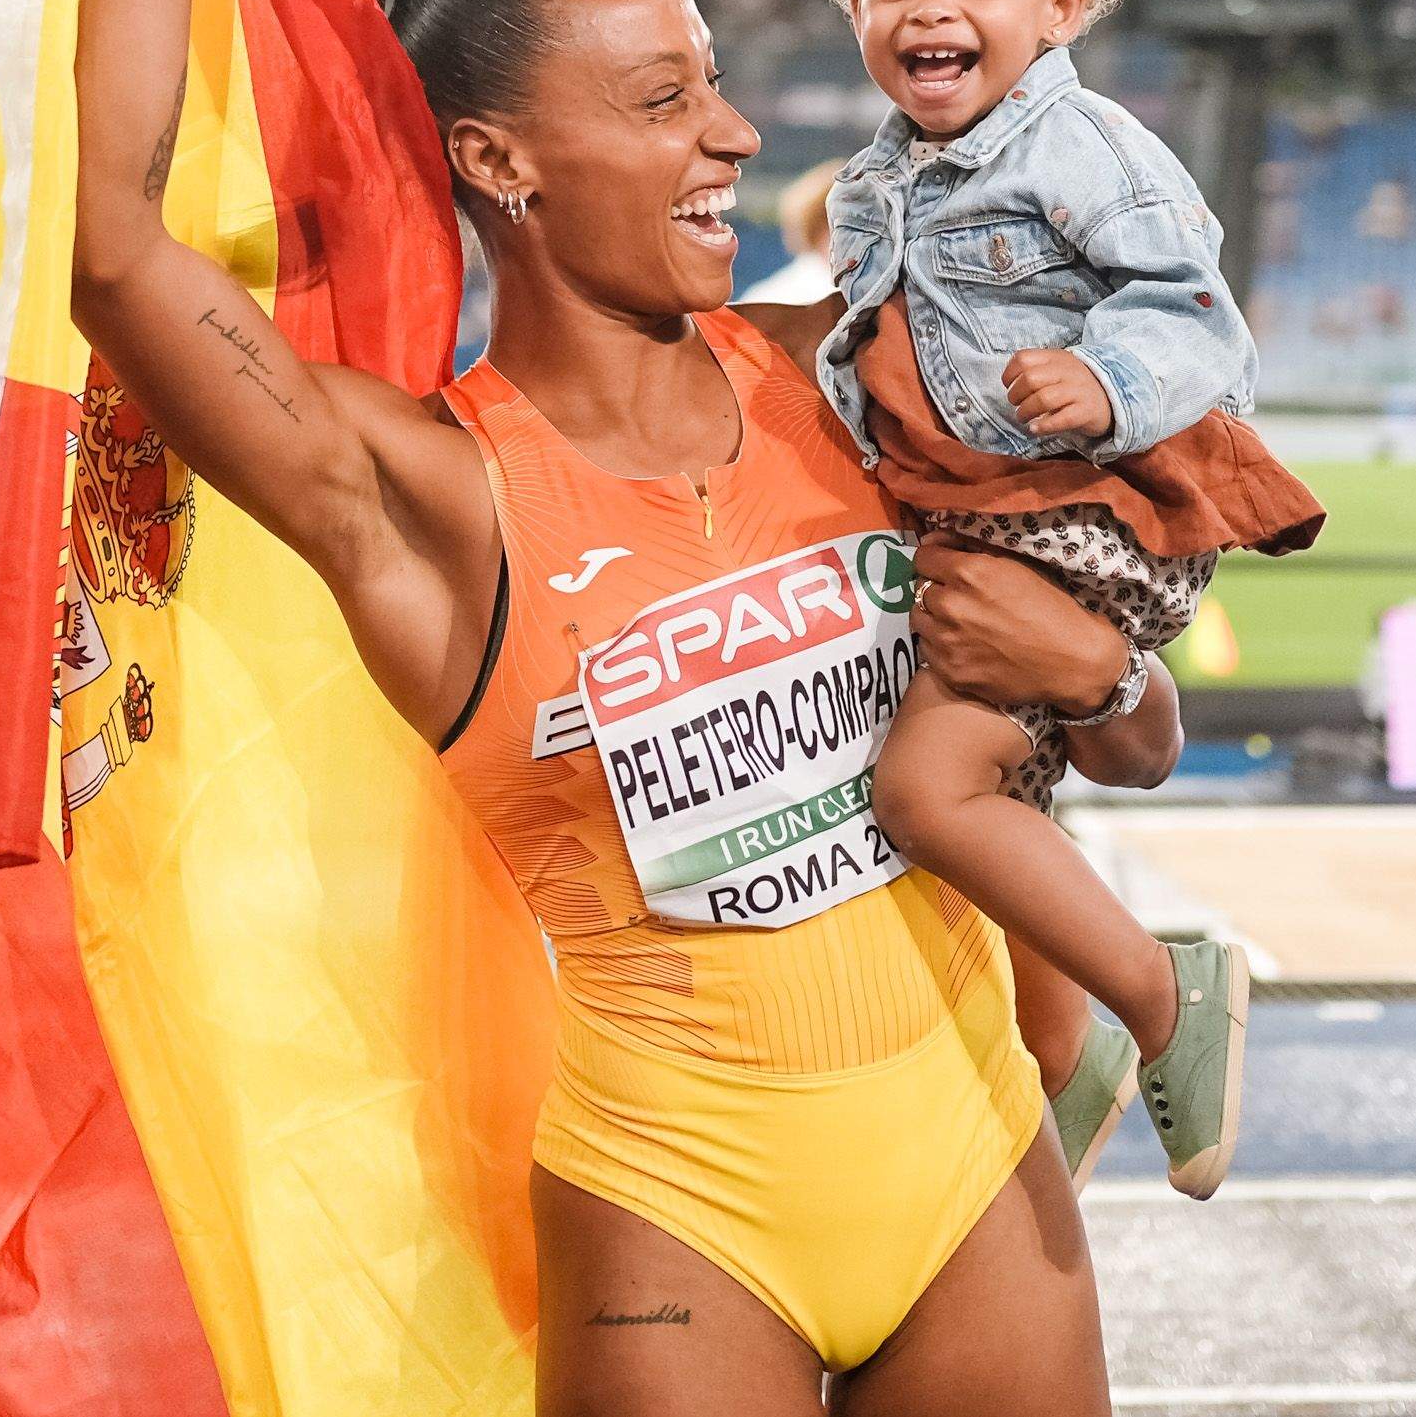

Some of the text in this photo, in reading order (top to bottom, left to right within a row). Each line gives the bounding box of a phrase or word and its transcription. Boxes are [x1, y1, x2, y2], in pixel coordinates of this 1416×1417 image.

[591, 563, 854, 709] SPAR
[719, 836, 734, 866] I
[736, 804, 814, 859] RUN
[707, 842, 864, 924] ROMA
